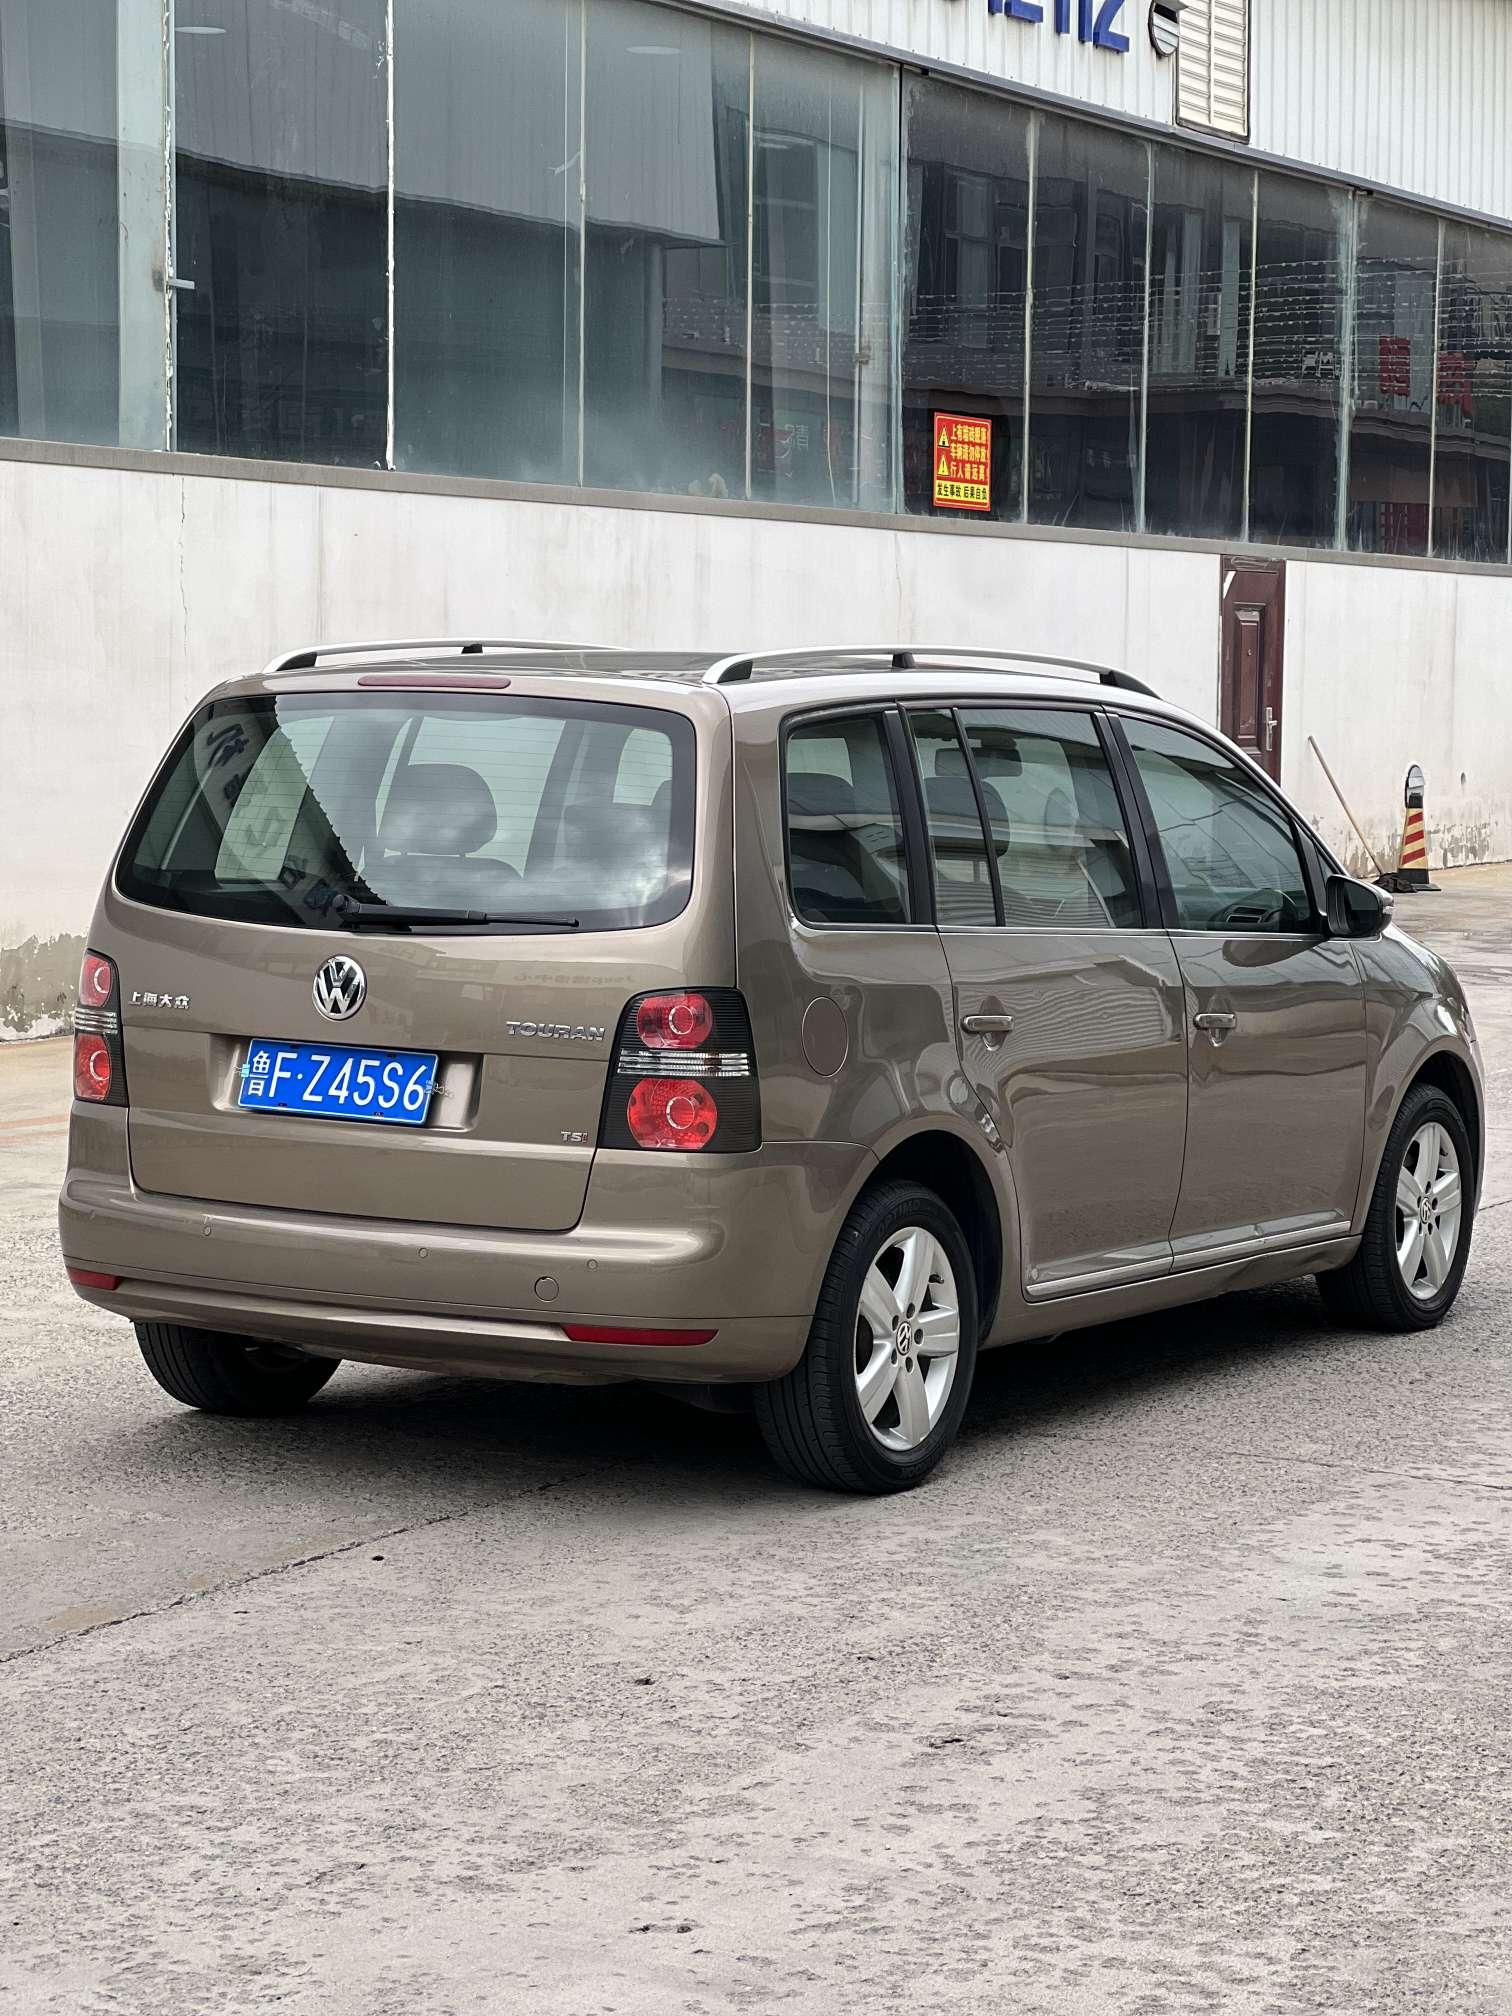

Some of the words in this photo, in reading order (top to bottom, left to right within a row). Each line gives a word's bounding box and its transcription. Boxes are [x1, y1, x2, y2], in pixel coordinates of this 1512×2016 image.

[128, 991, 190, 1009] 上海大众
[505, 1021, 605, 1041] TOURAN
[247, 1050, 428, 1111] 鲁F·Z45S6
